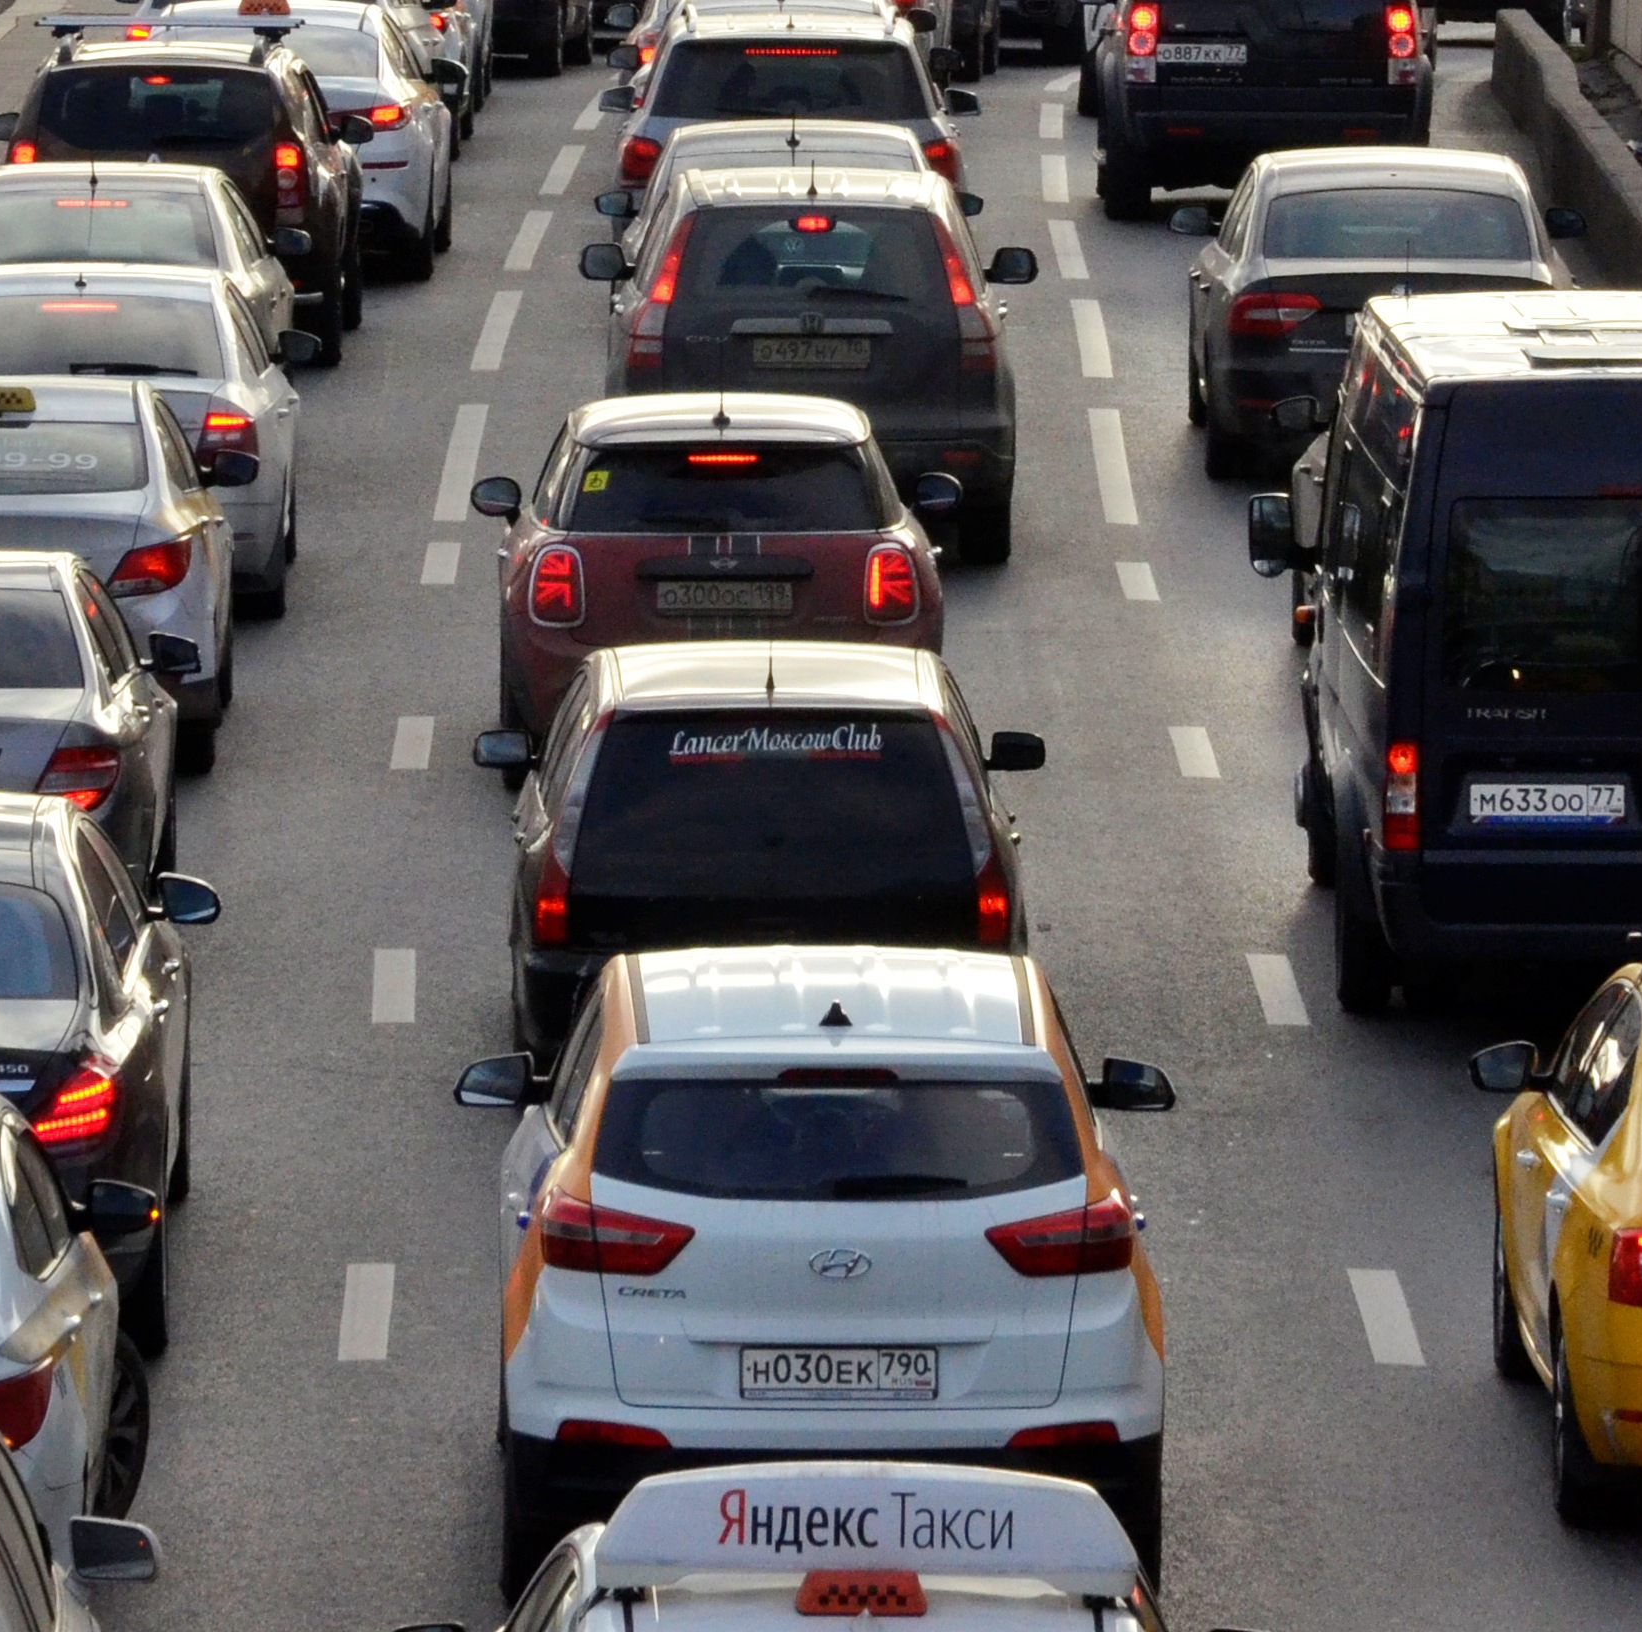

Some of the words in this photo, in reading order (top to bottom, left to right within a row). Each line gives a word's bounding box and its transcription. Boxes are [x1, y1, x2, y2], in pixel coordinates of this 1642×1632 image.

[1161, 46, 1222, 61] О887КК
[1226, 45, 1242, 58] 77
[663, 584, 748, 606] О300ОС
[1479, 788, 1584, 812] М633ОО
[1590, 787, 1616, 806] 77
[617, 1285, 687, 1299] CRETA
[752, 1352, 873, 1384] Н030ЕК
[881, 1352, 930, 1376] 790
[890, 1377, 914, 1386] RUS
[718, 1488, 879, 1554] Яндекс
[890, 1492, 1014, 1551] Такси
